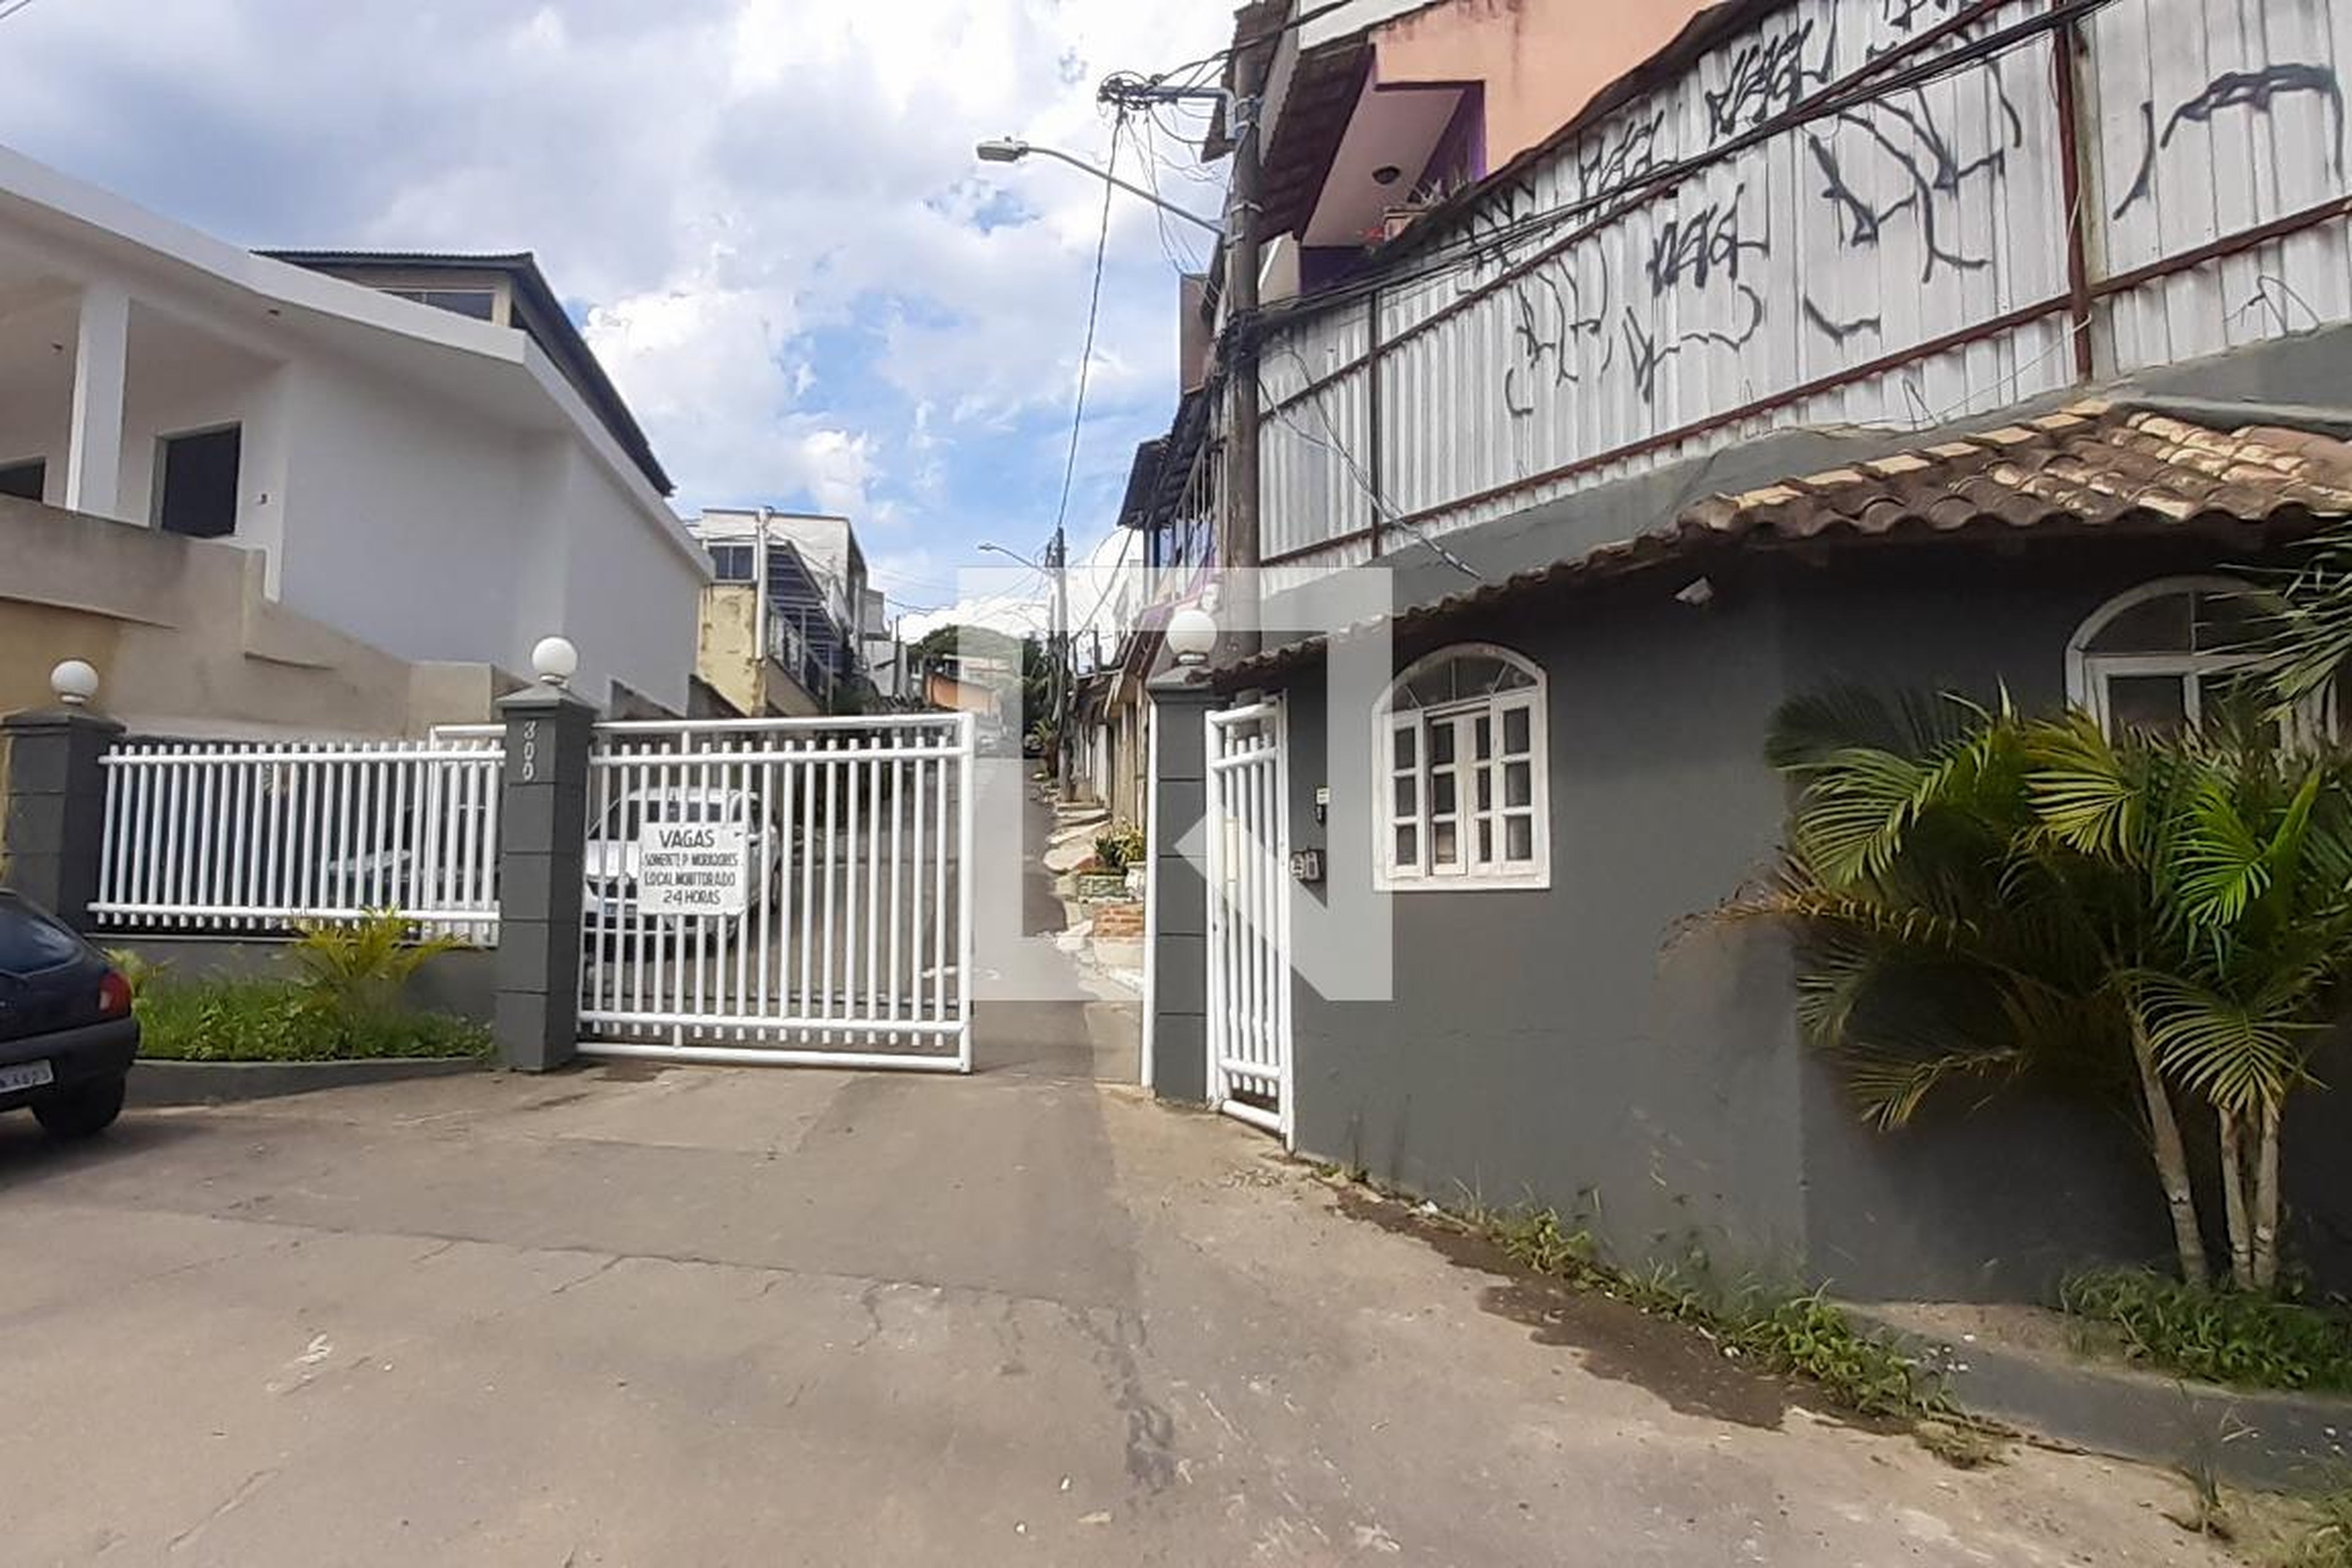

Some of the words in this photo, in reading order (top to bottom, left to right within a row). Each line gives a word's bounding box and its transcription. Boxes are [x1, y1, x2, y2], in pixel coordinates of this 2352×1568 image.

[659, 830, 715, 848] VAGAS
[645, 872, 674, 886] LOCAL
[663, 890, 682, 905] 24
[684, 890, 721, 905] HORAS
